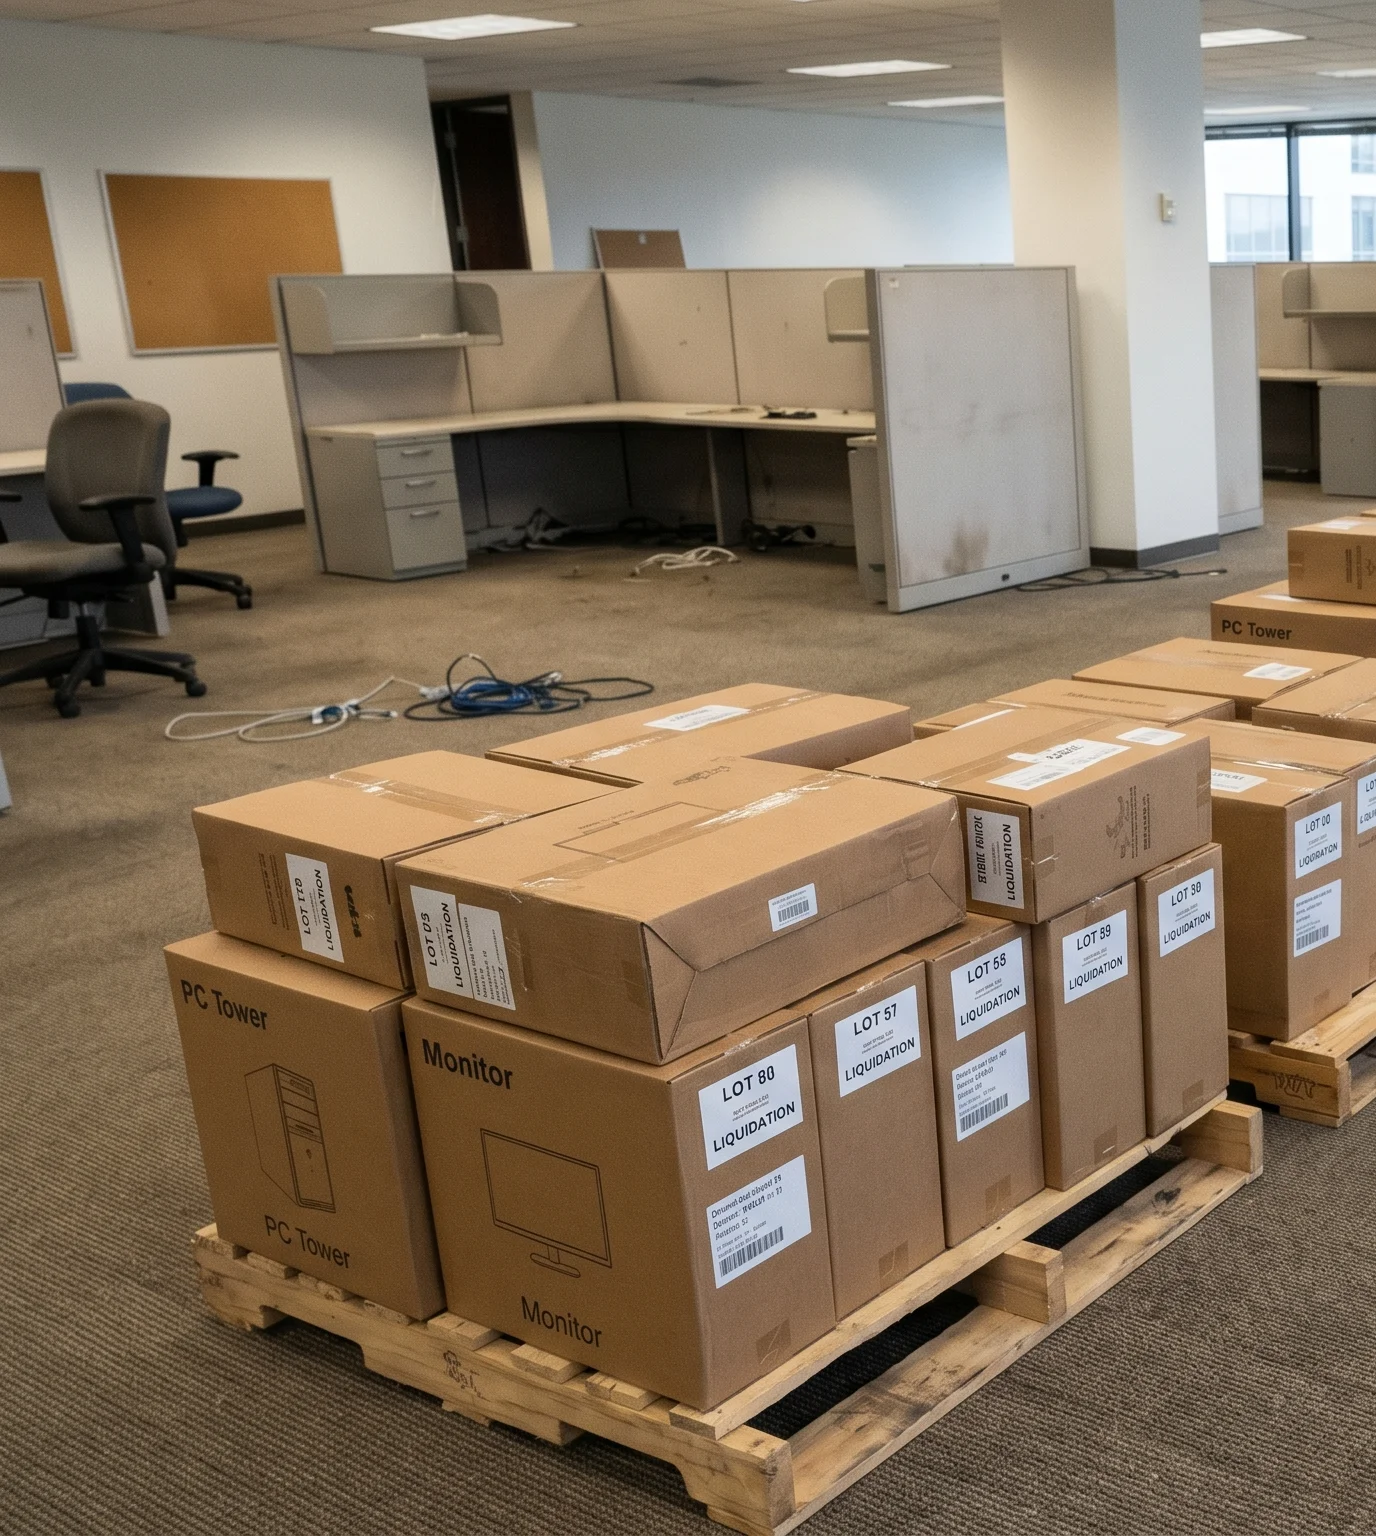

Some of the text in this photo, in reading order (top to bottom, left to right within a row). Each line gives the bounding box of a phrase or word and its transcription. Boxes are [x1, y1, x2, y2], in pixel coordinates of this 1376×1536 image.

[1222, 619, 1292, 640] PC Tower
[1171, 887, 1189, 907] LOT
[300, 907, 311, 935] LOT
[1164, 911, 1211, 944] LIQUIDATION
[426, 938, 438, 966] LOT
[1076, 930, 1097, 951] LOT
[968, 961, 991, 984] LOT
[1069, 956, 1123, 990] LIQUIDATION
[181, 979, 268, 1030] PC Tower
[853, 1003, 898, 1036] LOT 57
[960, 985, 1020, 1026] LIQUIDATION
[422, 1038, 514, 1090] Monitor
[845, 1037, 915, 1082] LIQUIDATION
[722, 1074, 753, 1103] LOT
[713, 1101, 795, 1152] LIQUIDATION
[265, 1215, 350, 1269] PC Tower
[521, 1296, 602, 1347] Monitor
